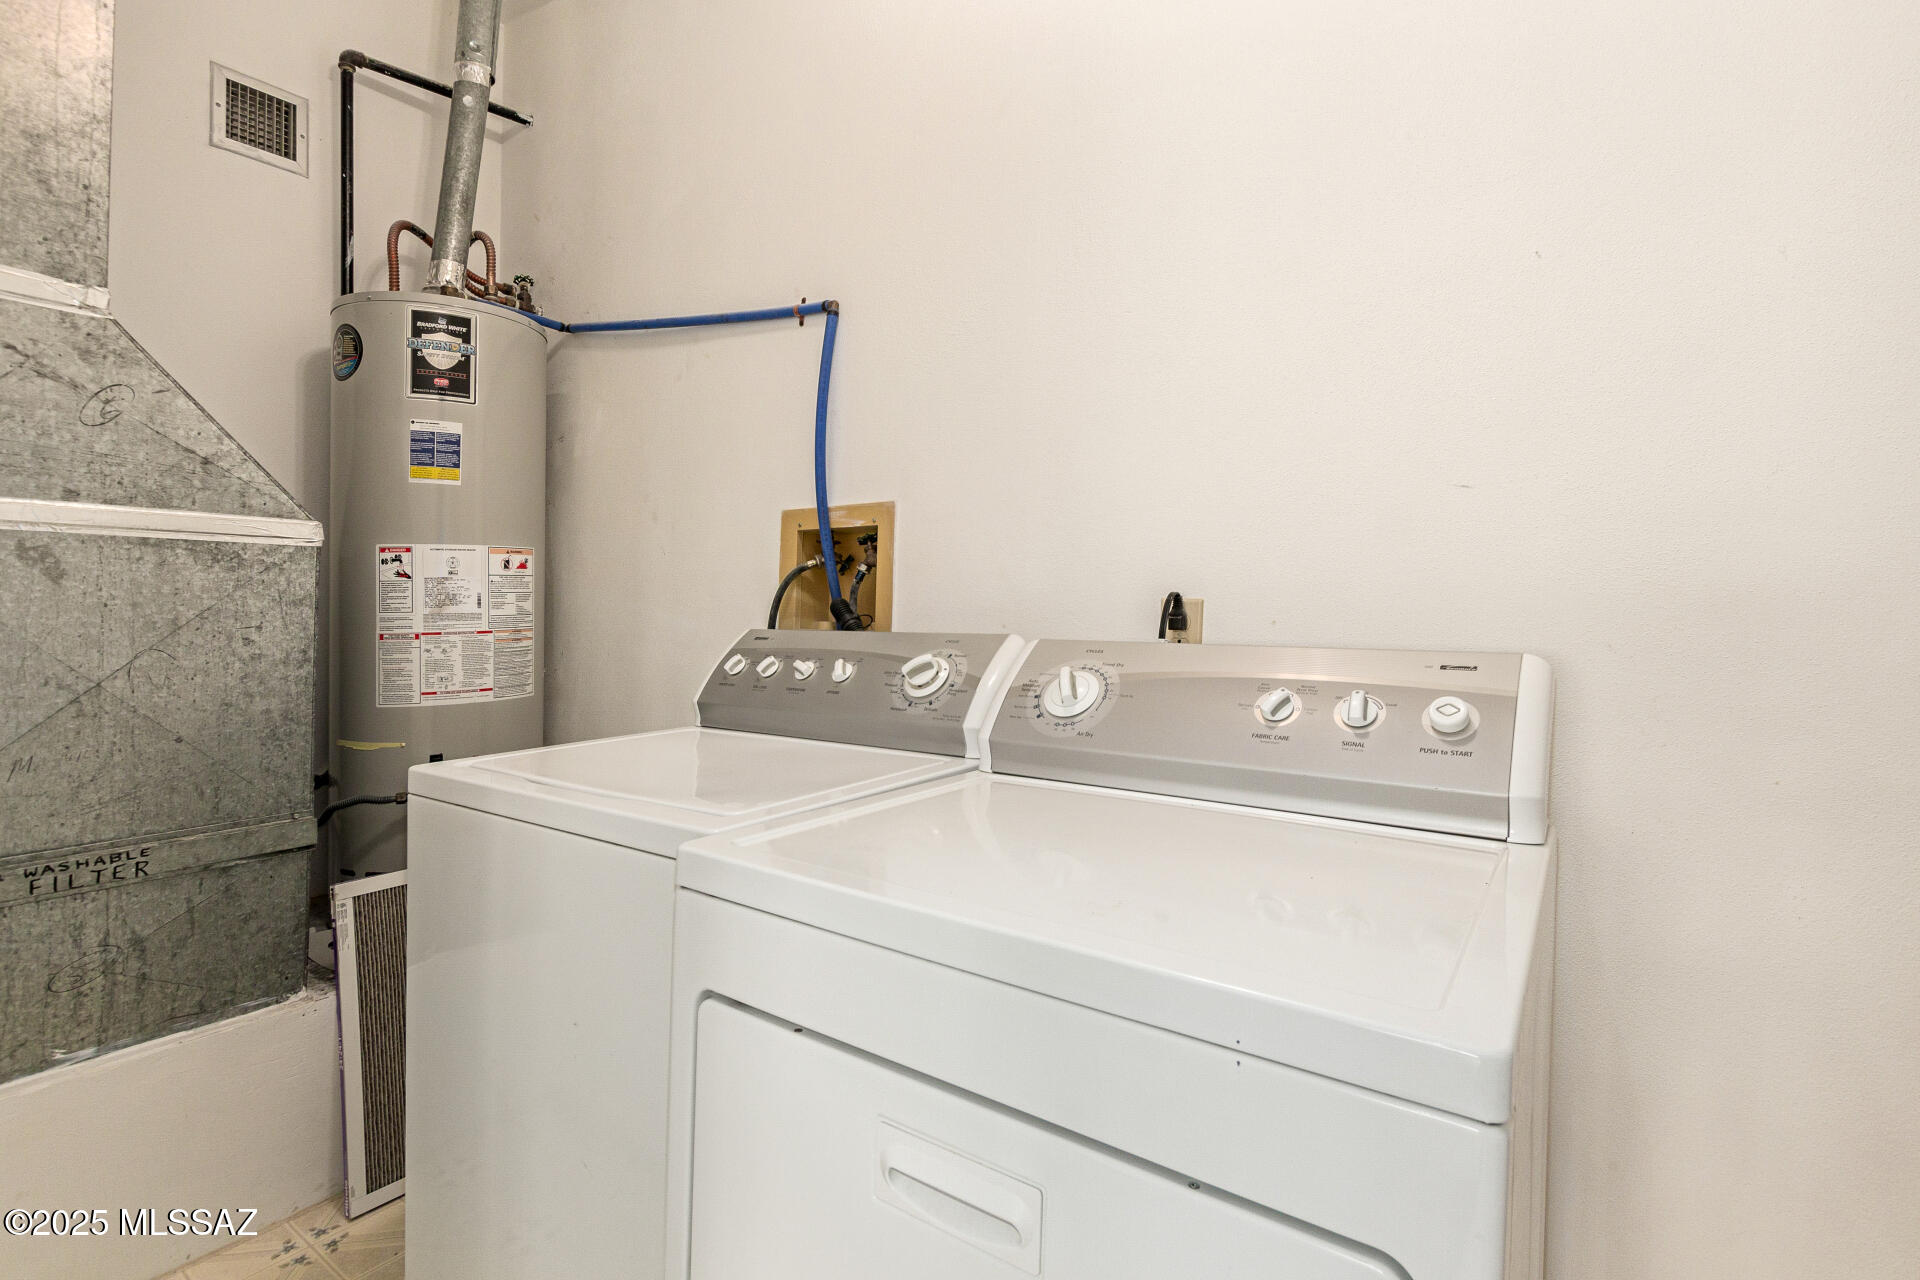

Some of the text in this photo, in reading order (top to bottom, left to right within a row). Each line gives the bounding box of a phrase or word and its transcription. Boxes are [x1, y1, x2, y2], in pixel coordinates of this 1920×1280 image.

[407, 337, 477, 355] DEFENDER
[23, 847, 151, 879] WASHABLE
[28, 860, 150, 895] FILTER
